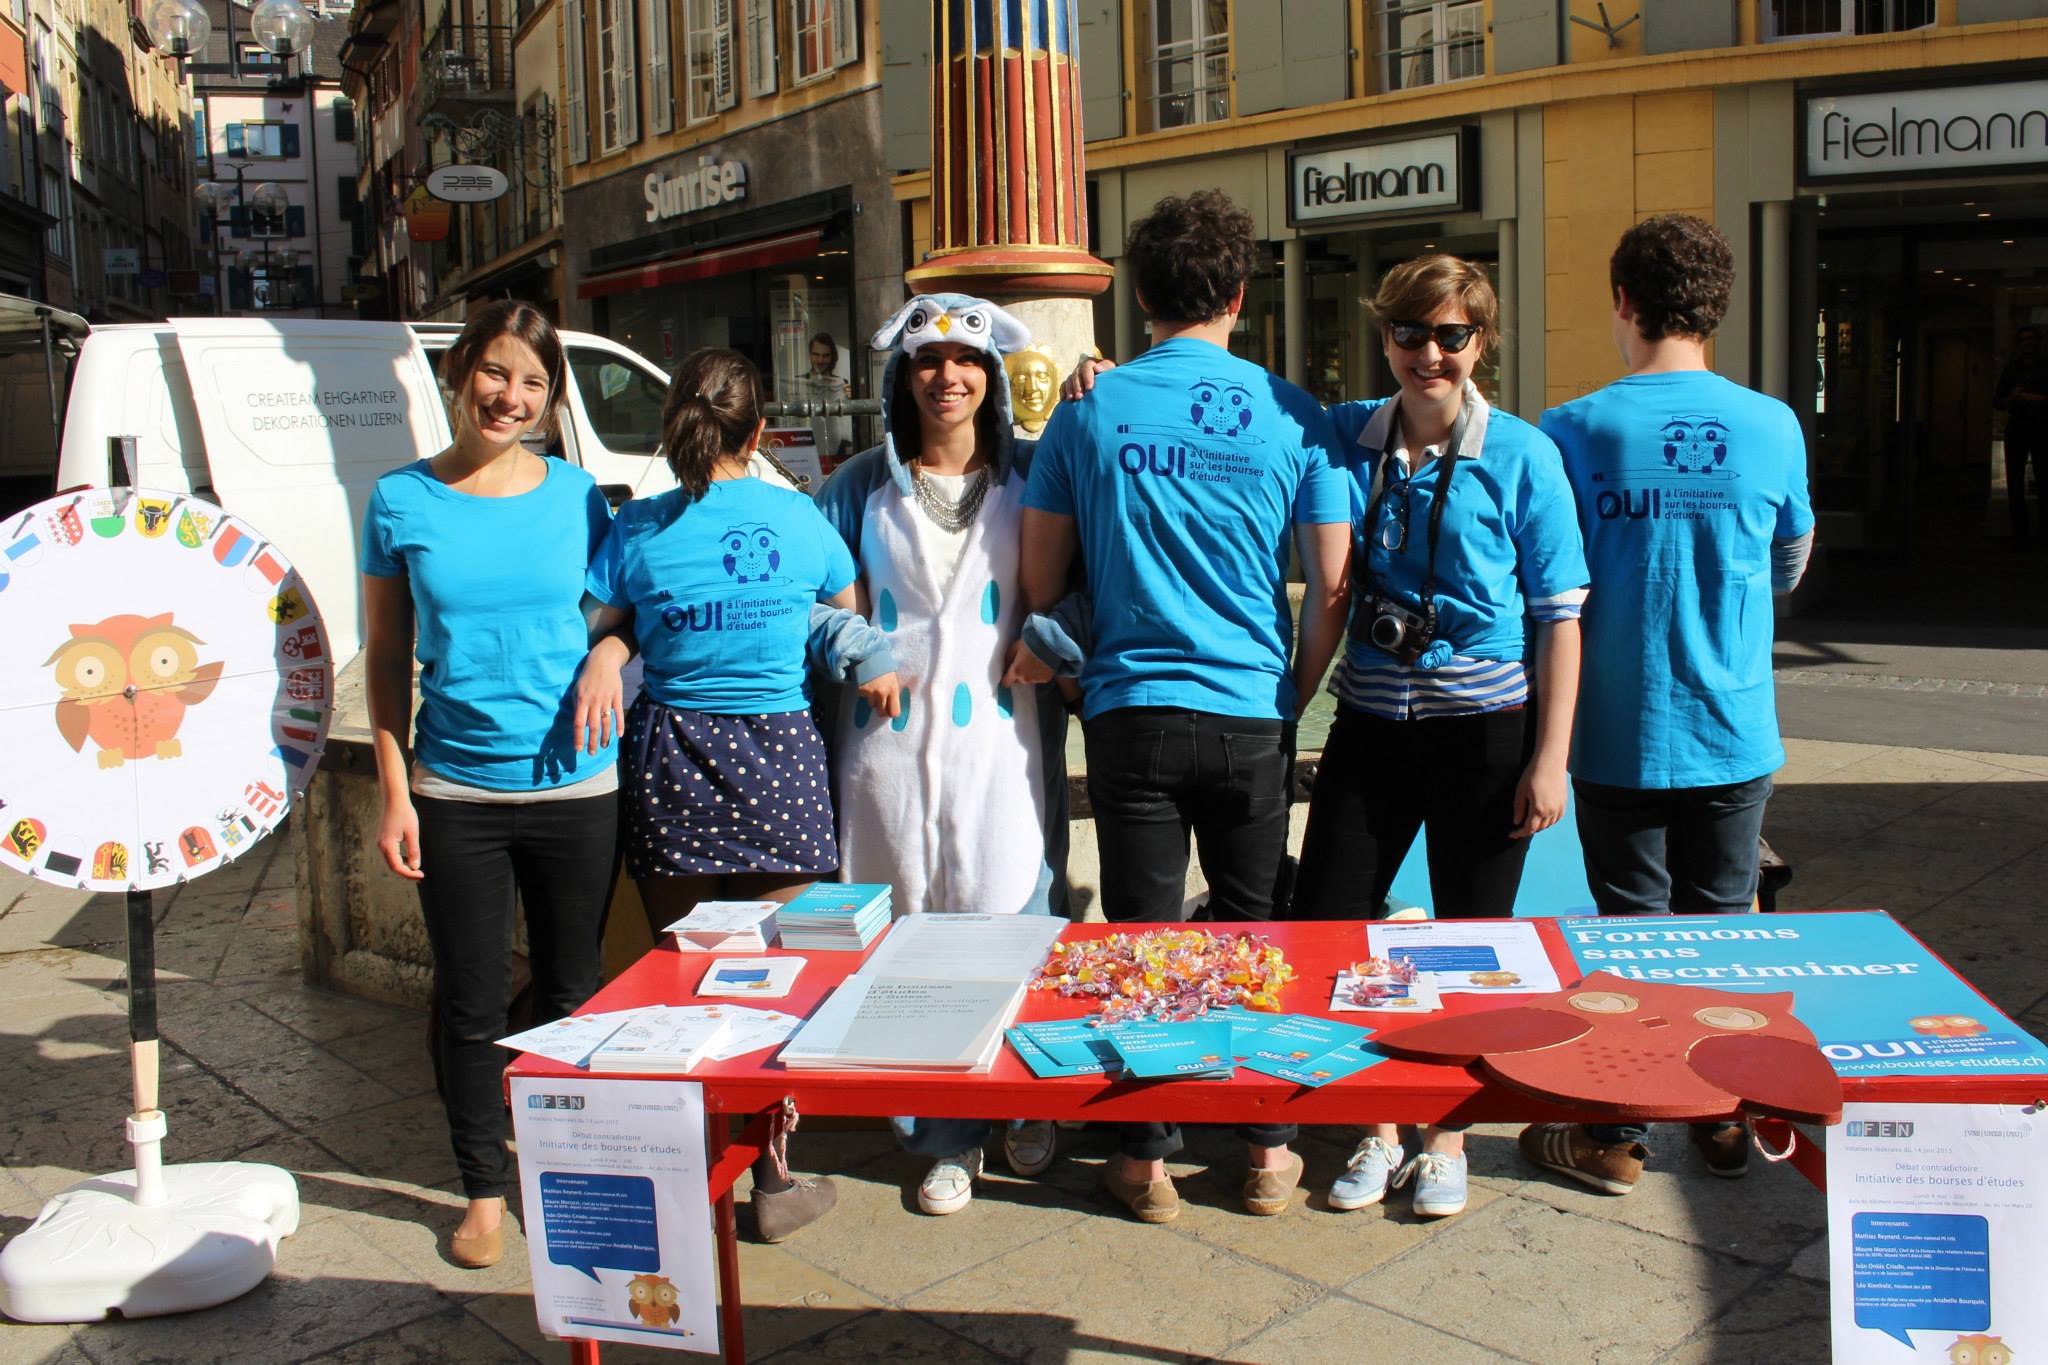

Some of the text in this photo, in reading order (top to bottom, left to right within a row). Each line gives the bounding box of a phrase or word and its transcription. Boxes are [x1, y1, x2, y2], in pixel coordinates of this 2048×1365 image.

[1823, 106, 2048, 161] fielmann
[644, 156, 745, 223] Sunrise
[1303, 162, 1444, 207] fielmann
[247, 390, 398, 408] CREATEAM EHGARTNER
[253, 412, 403, 431] DEKORATIONEN LUZERN
[1118, 443, 1186, 478] OUI
[1200, 450, 1250, 463] l'initiative
[1190, 460, 1264, 477] sur les bourses
[1190, 470, 1231, 483] d'études
[1674, 488, 1724, 499] l'initiative
[1596, 488, 1661, 520] OUI
[1665, 499, 1738, 510] sur les bourses
[1665, 510, 1705, 520] d'études
[735, 598, 782, 609] l'initiative
[661, 600, 723, 632] OUI
[726, 606, 793, 621] sur les bourses
[726, 620, 767, 631] d'études
[1572, 928, 1800, 945] Formons
[1582, 946, 1701, 960] sans
[1115, 1032, 1169, 1041] Formons
[1123, 1041, 1197, 1050] discriminer
[1820, 1041, 1926, 1061] OUI
[1176, 1062, 1205, 1071] OUI
[1832, 1055, 2046, 1072] www.bourses-etudes.ch
[539, 1140, 681, 1155] Initiative des bourses d'études
[1895, 1162, 1979, 1172] Débat contradictoire
[1855, 1173, 2025, 1187] Initiative des bourses d'études
